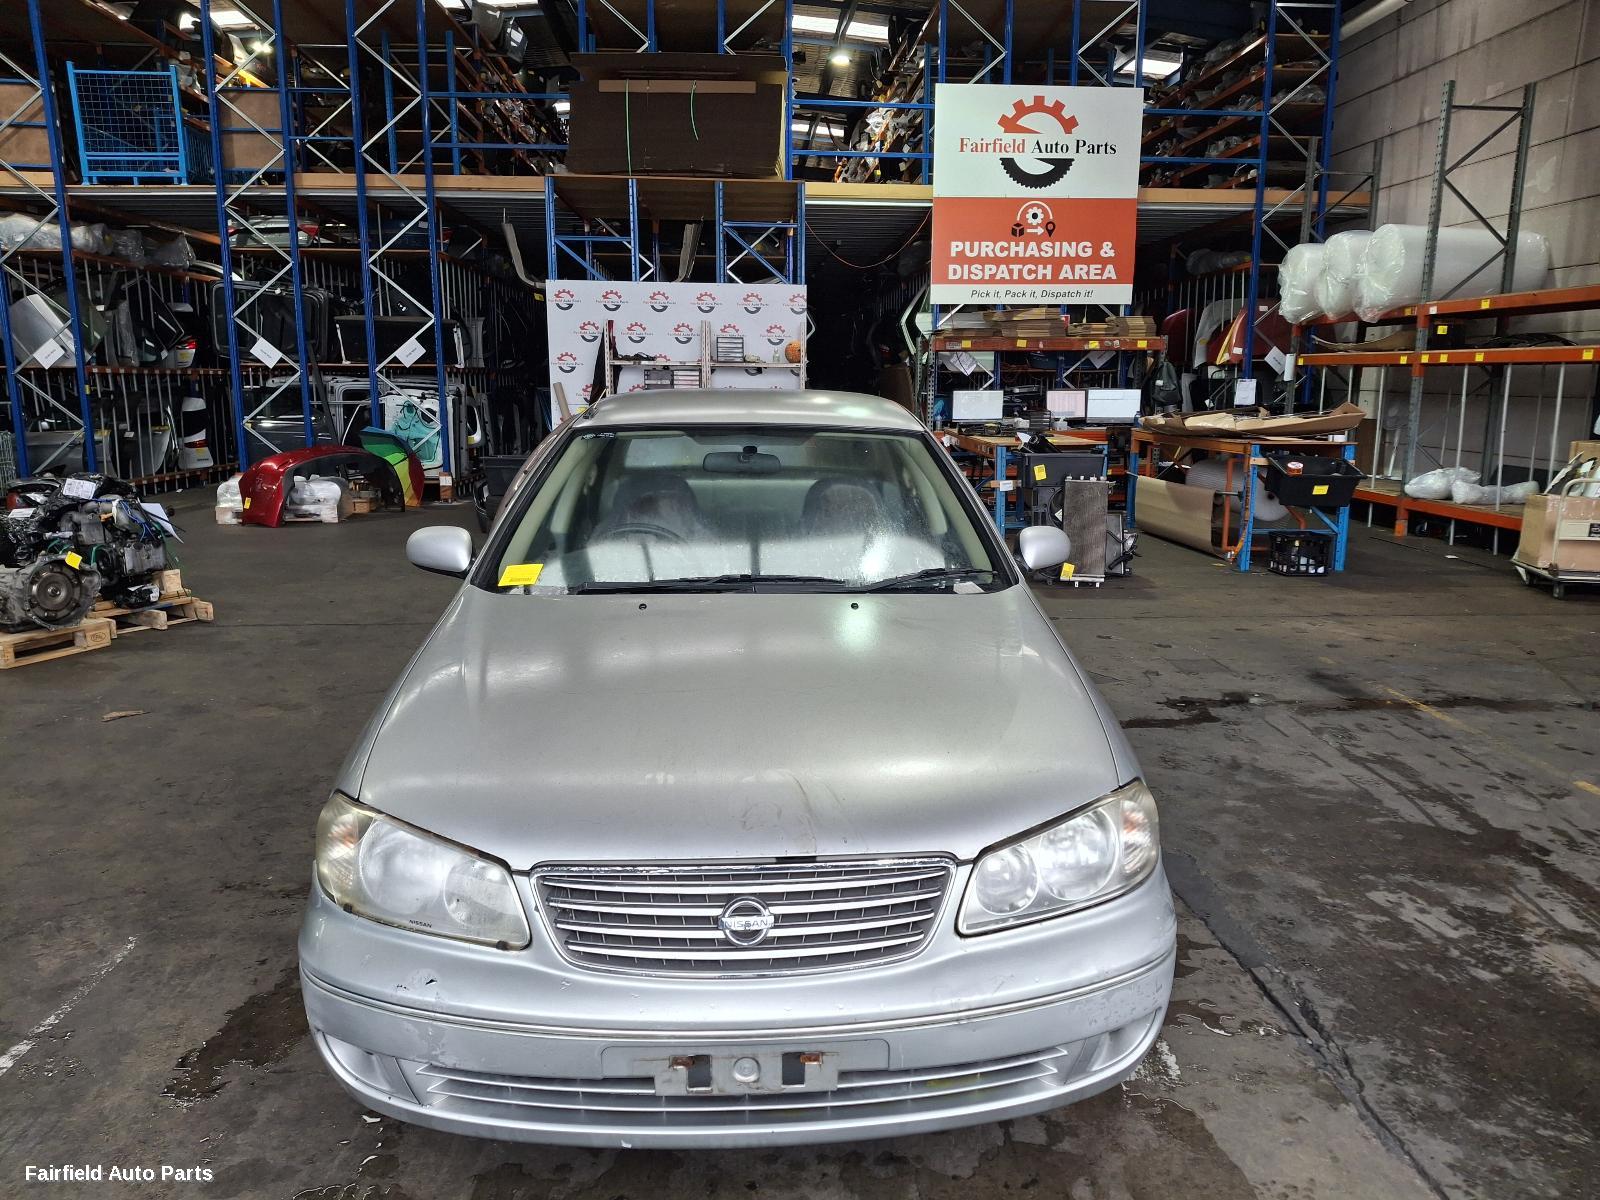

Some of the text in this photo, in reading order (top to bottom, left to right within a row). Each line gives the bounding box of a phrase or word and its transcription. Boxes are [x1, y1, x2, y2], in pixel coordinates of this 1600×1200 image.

[959, 137, 1117, 155] Fairfield Auto Parts
[950, 241, 1116, 258] PURCHASING &
[947, 263, 1117, 280] DISPATCH AREA
[970, 289, 991, 298] Pick
[1004, 289, 1027, 298] Pack
[1029, 289, 1038, 299] it,
[1040, 289, 1082, 299] Dispatch
[1083, 289, 1094, 298] it!
[409, 920, 432, 928] NISSAN
[724, 919, 768, 928] NISSAN
